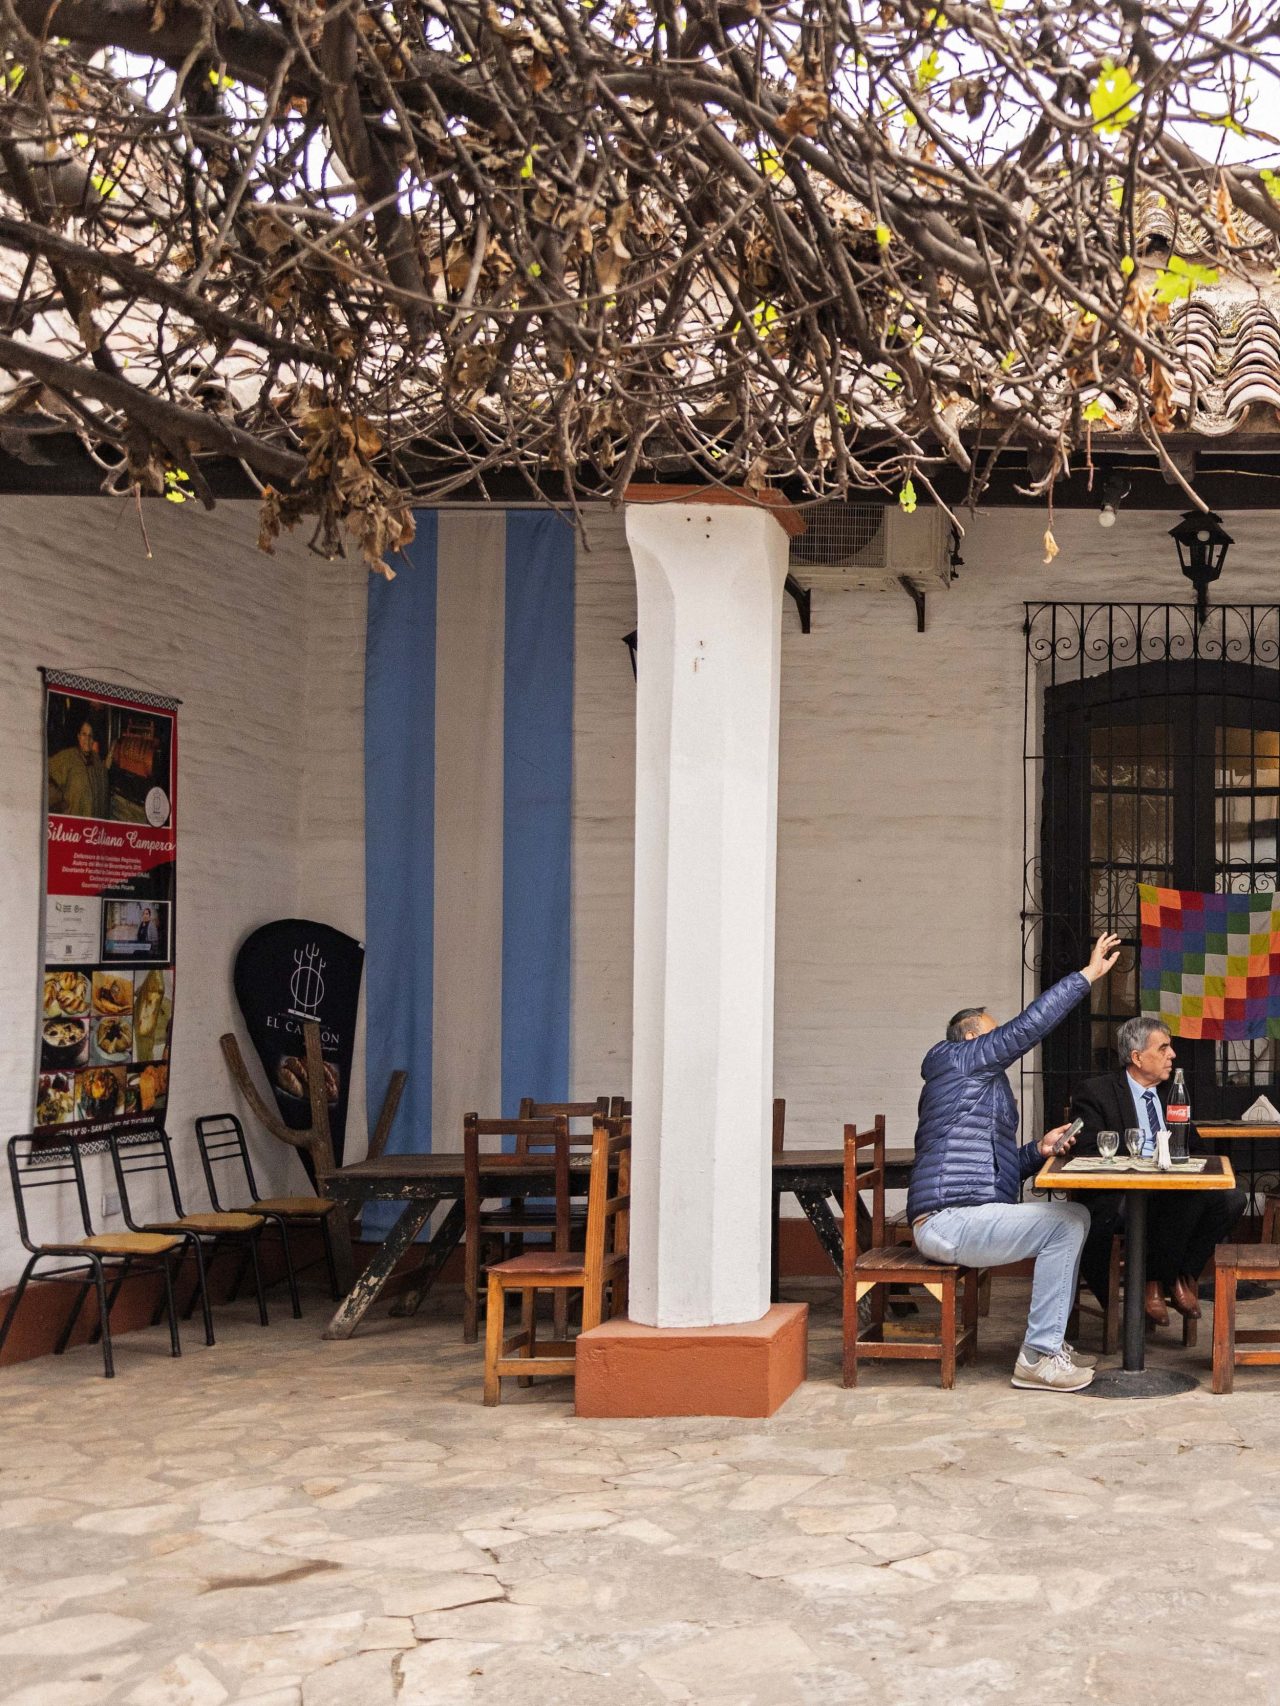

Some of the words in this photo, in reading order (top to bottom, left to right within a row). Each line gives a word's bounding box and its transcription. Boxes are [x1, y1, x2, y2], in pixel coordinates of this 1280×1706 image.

[48, 822, 82, 843] Silvia
[82, 826, 124, 847] Liliana
[126, 830, 176, 856] Campero
[266, 1016, 279, 1029] EL
[91, 1124, 102, 1133] SAN
